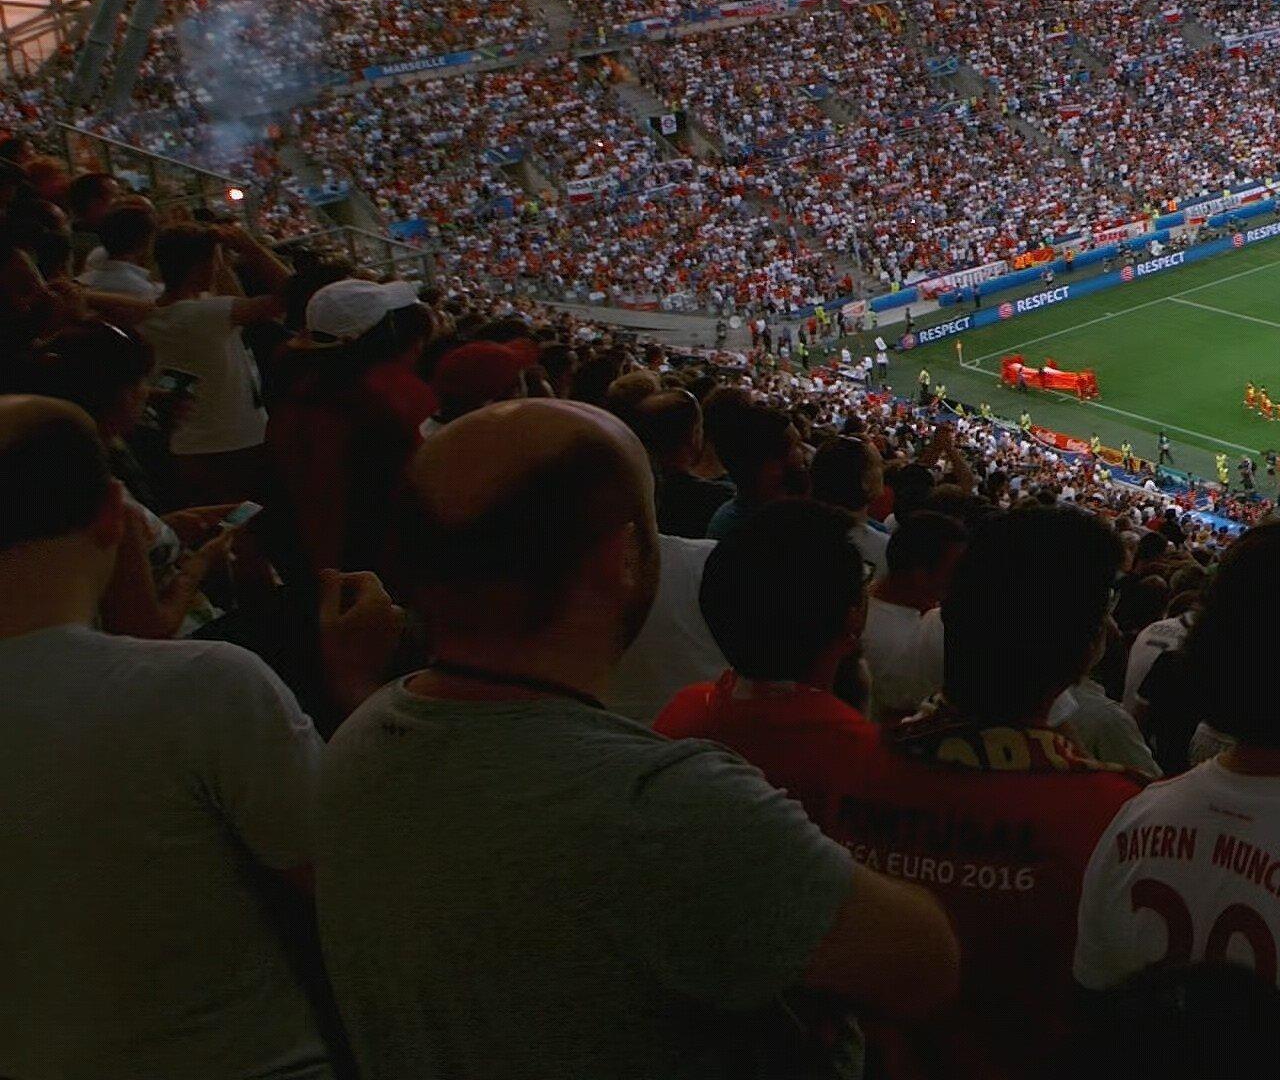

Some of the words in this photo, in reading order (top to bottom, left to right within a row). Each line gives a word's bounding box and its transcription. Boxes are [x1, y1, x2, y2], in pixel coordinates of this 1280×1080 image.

[383, 56, 446, 75] MARSEILLE
[1137, 251, 1184, 276] RESPECT
[1017, 286, 1070, 312] RESPECT
[919, 317, 970, 344] RESPECT
[1116, 826, 1197, 863] BAYERN
[886, 852, 955, 884] EURO
[961, 864, 1035, 891] 2016
